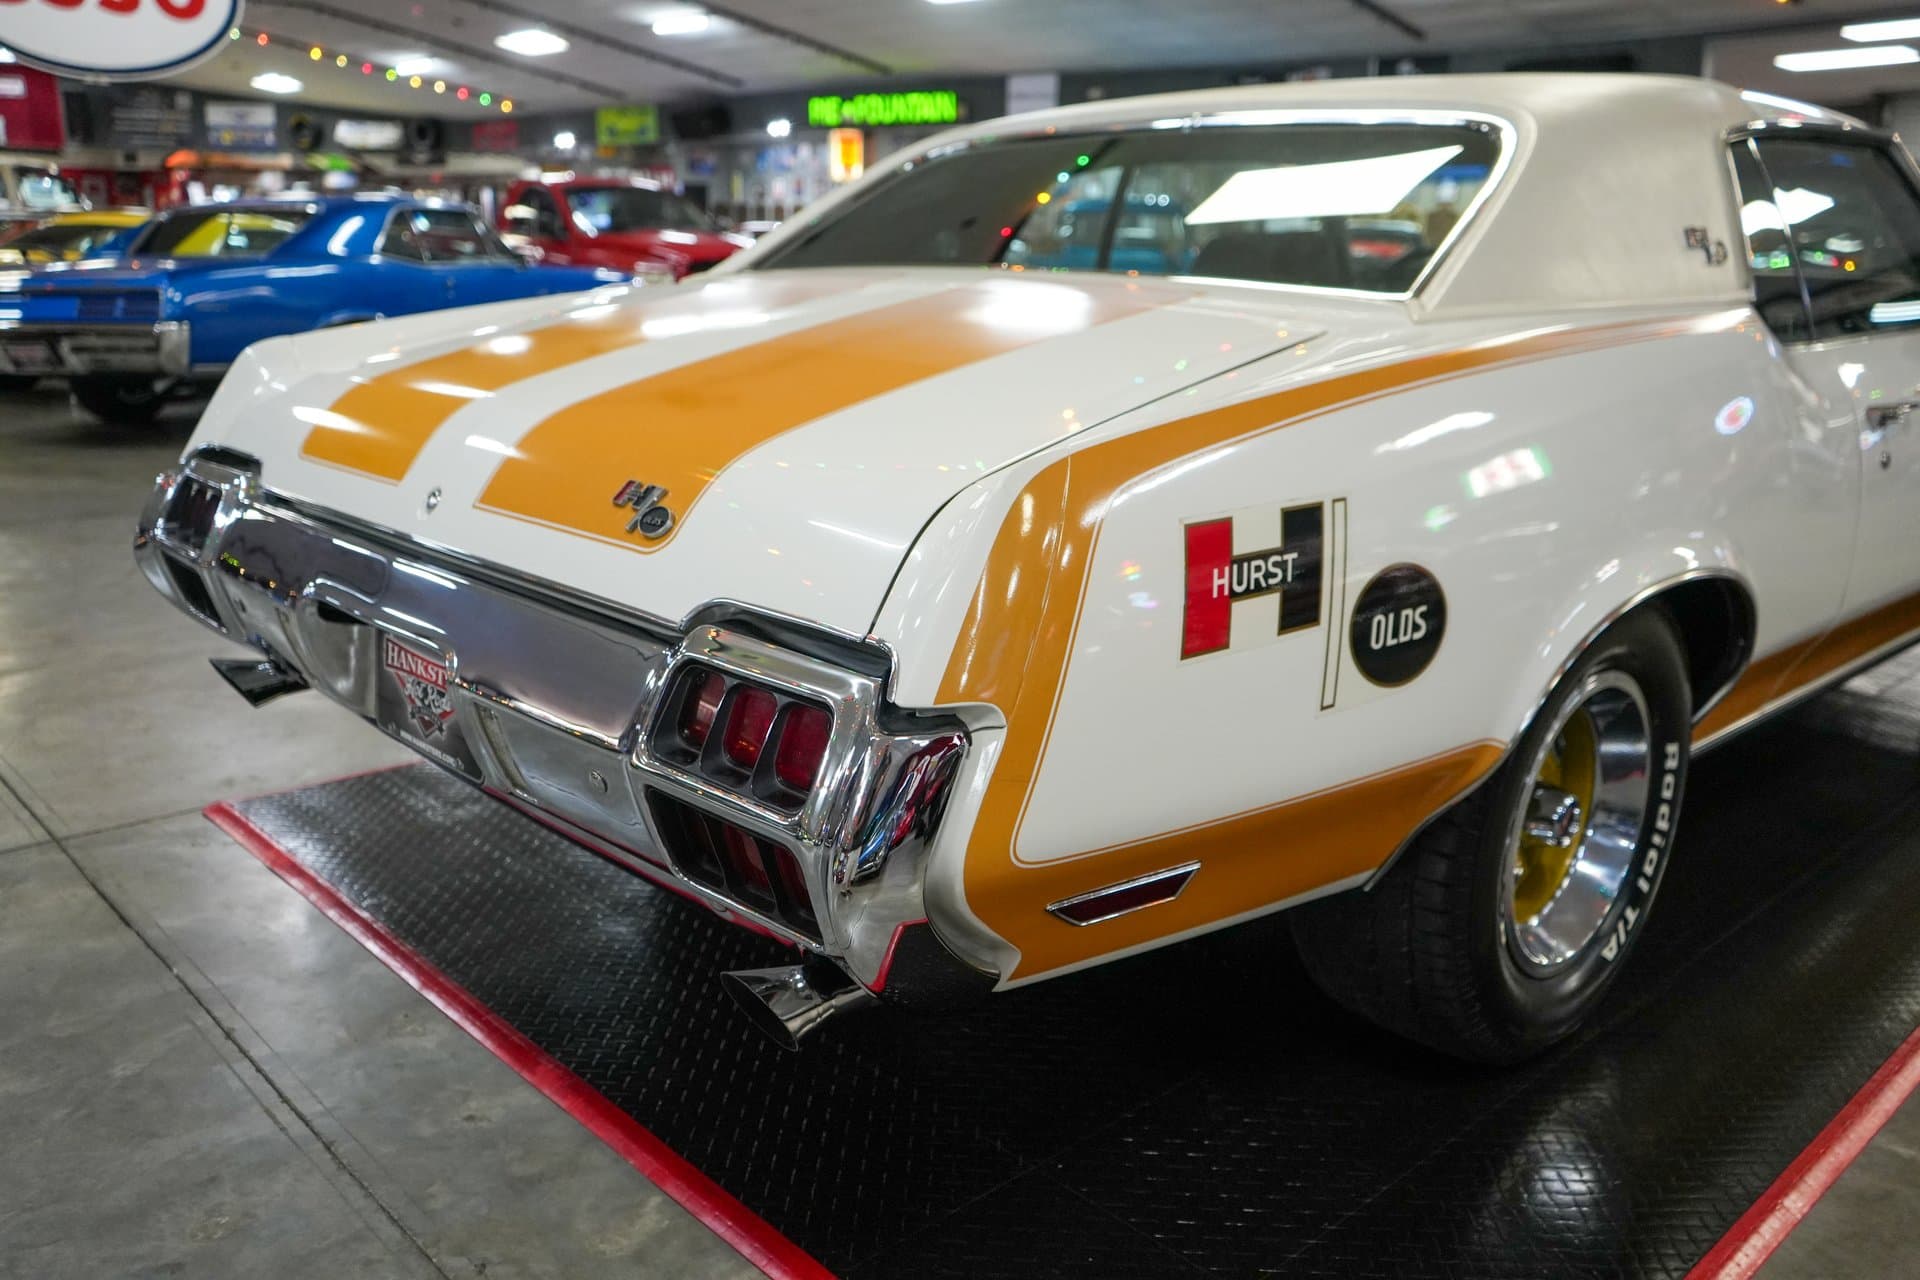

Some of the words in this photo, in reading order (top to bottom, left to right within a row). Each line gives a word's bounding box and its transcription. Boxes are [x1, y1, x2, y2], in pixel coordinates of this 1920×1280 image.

[1212, 552, 1299, 599] HURST
[1370, 605, 1428, 650] OLDS
[1637, 742, 1680, 894] Radial
[1601, 905, 1640, 962] T/A
